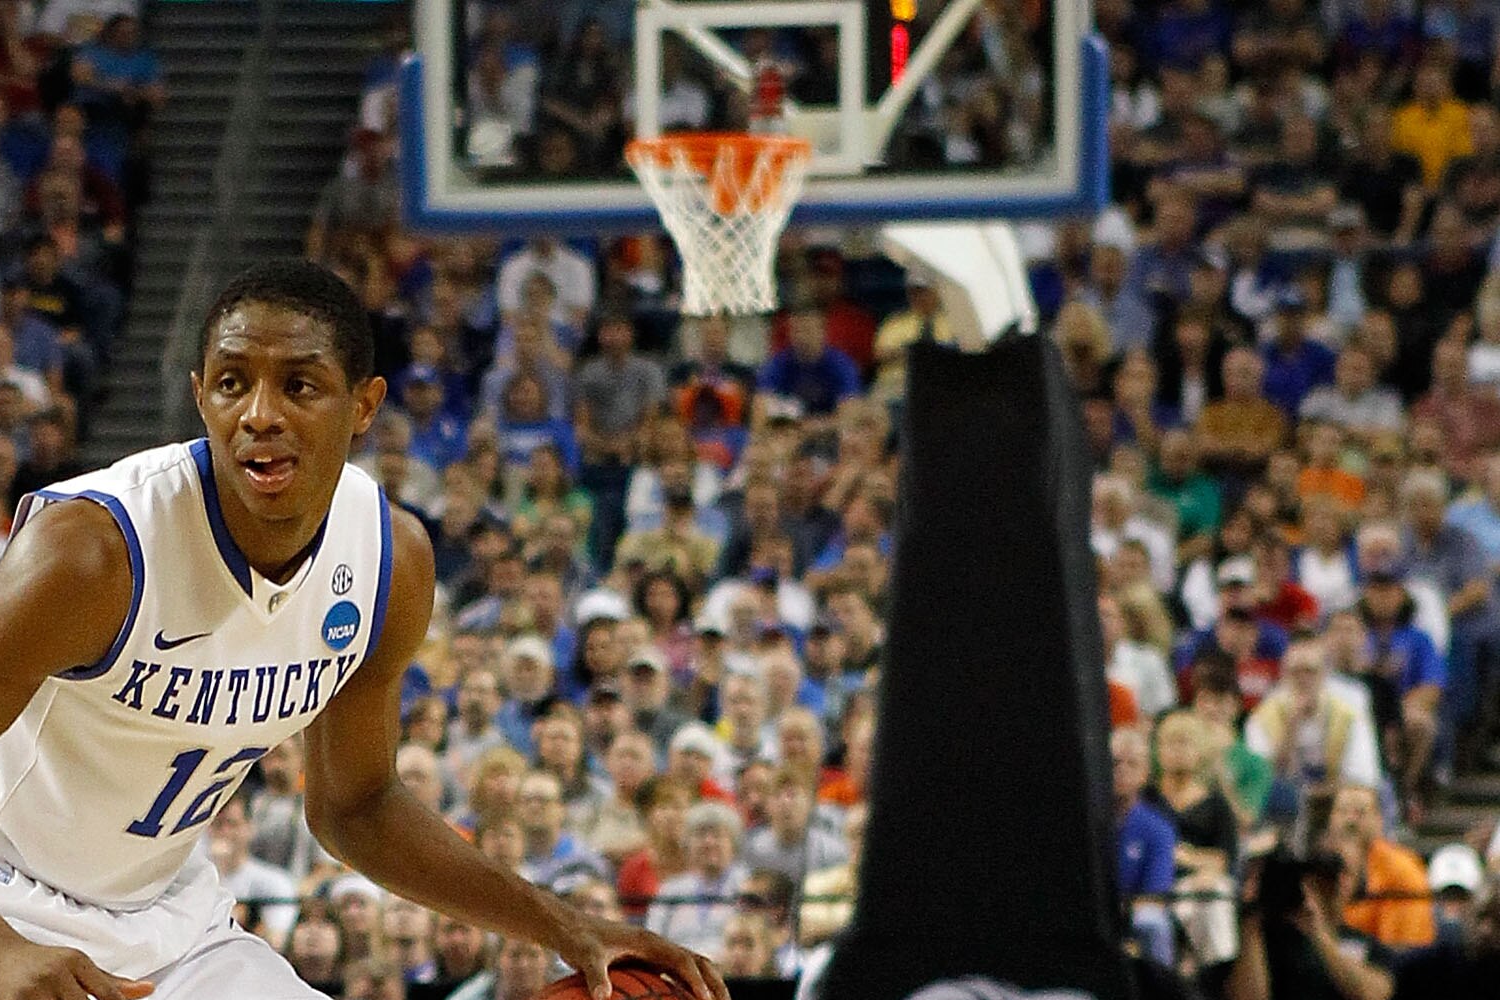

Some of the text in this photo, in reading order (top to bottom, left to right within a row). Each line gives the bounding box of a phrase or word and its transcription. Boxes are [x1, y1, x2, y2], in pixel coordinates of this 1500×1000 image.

[332, 564, 353, 595] SEC
[327, 623, 356, 641] NCAA
[111, 652, 357, 726] KENTUCKY
[125, 746, 271, 839] 12
